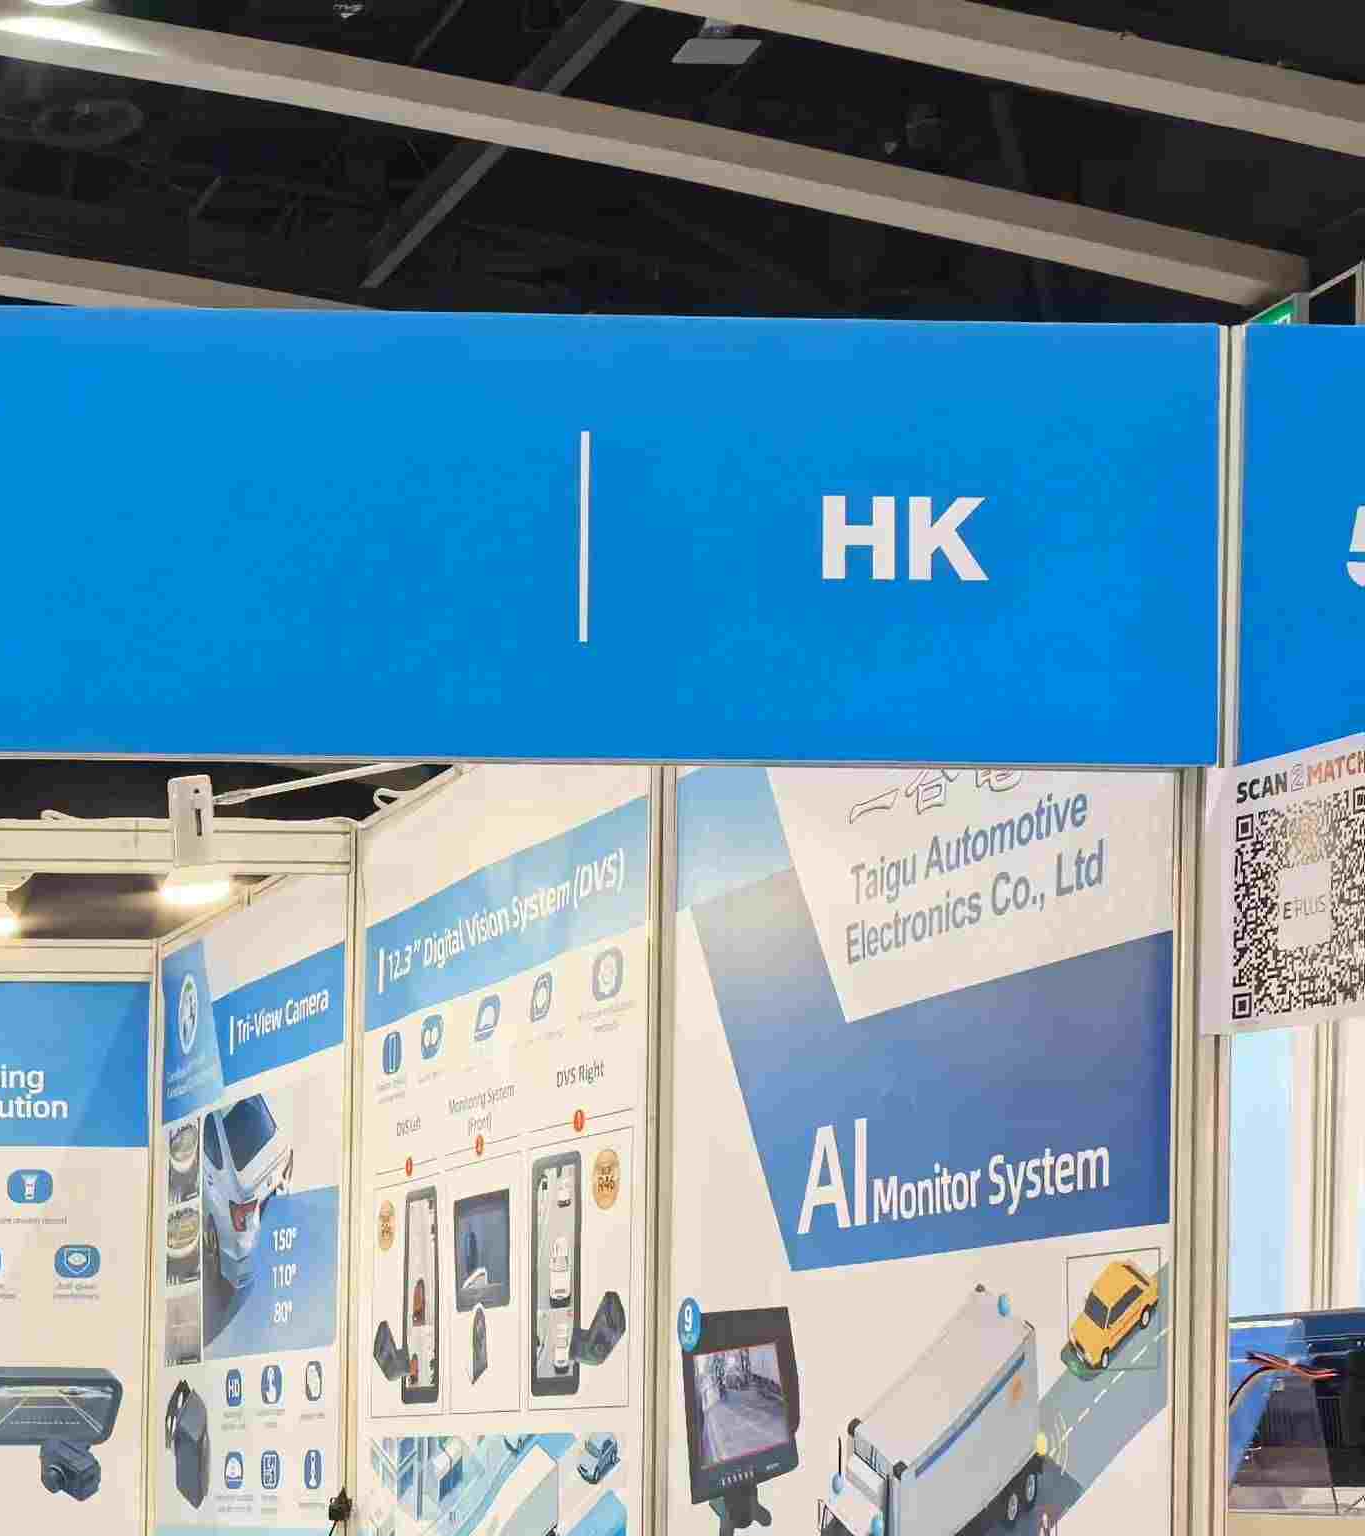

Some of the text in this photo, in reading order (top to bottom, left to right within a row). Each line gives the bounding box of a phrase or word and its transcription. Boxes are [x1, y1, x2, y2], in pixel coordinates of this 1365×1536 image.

[820, 494, 990, 581] HK
[845, 839, 1106, 965] Electronics Co., Ltd
[849, 791, 1088, 907] Taigu Automotive
[422, 921, 466, 969] Digital
[465, 905, 510, 951] Vision
[509, 876, 572, 930] System
[571, 848, 625, 912] (DVS)
[236, 989, 330, 1046] Tri-View Camera
[797, 1117, 1110, 1235] AI Monitor System
